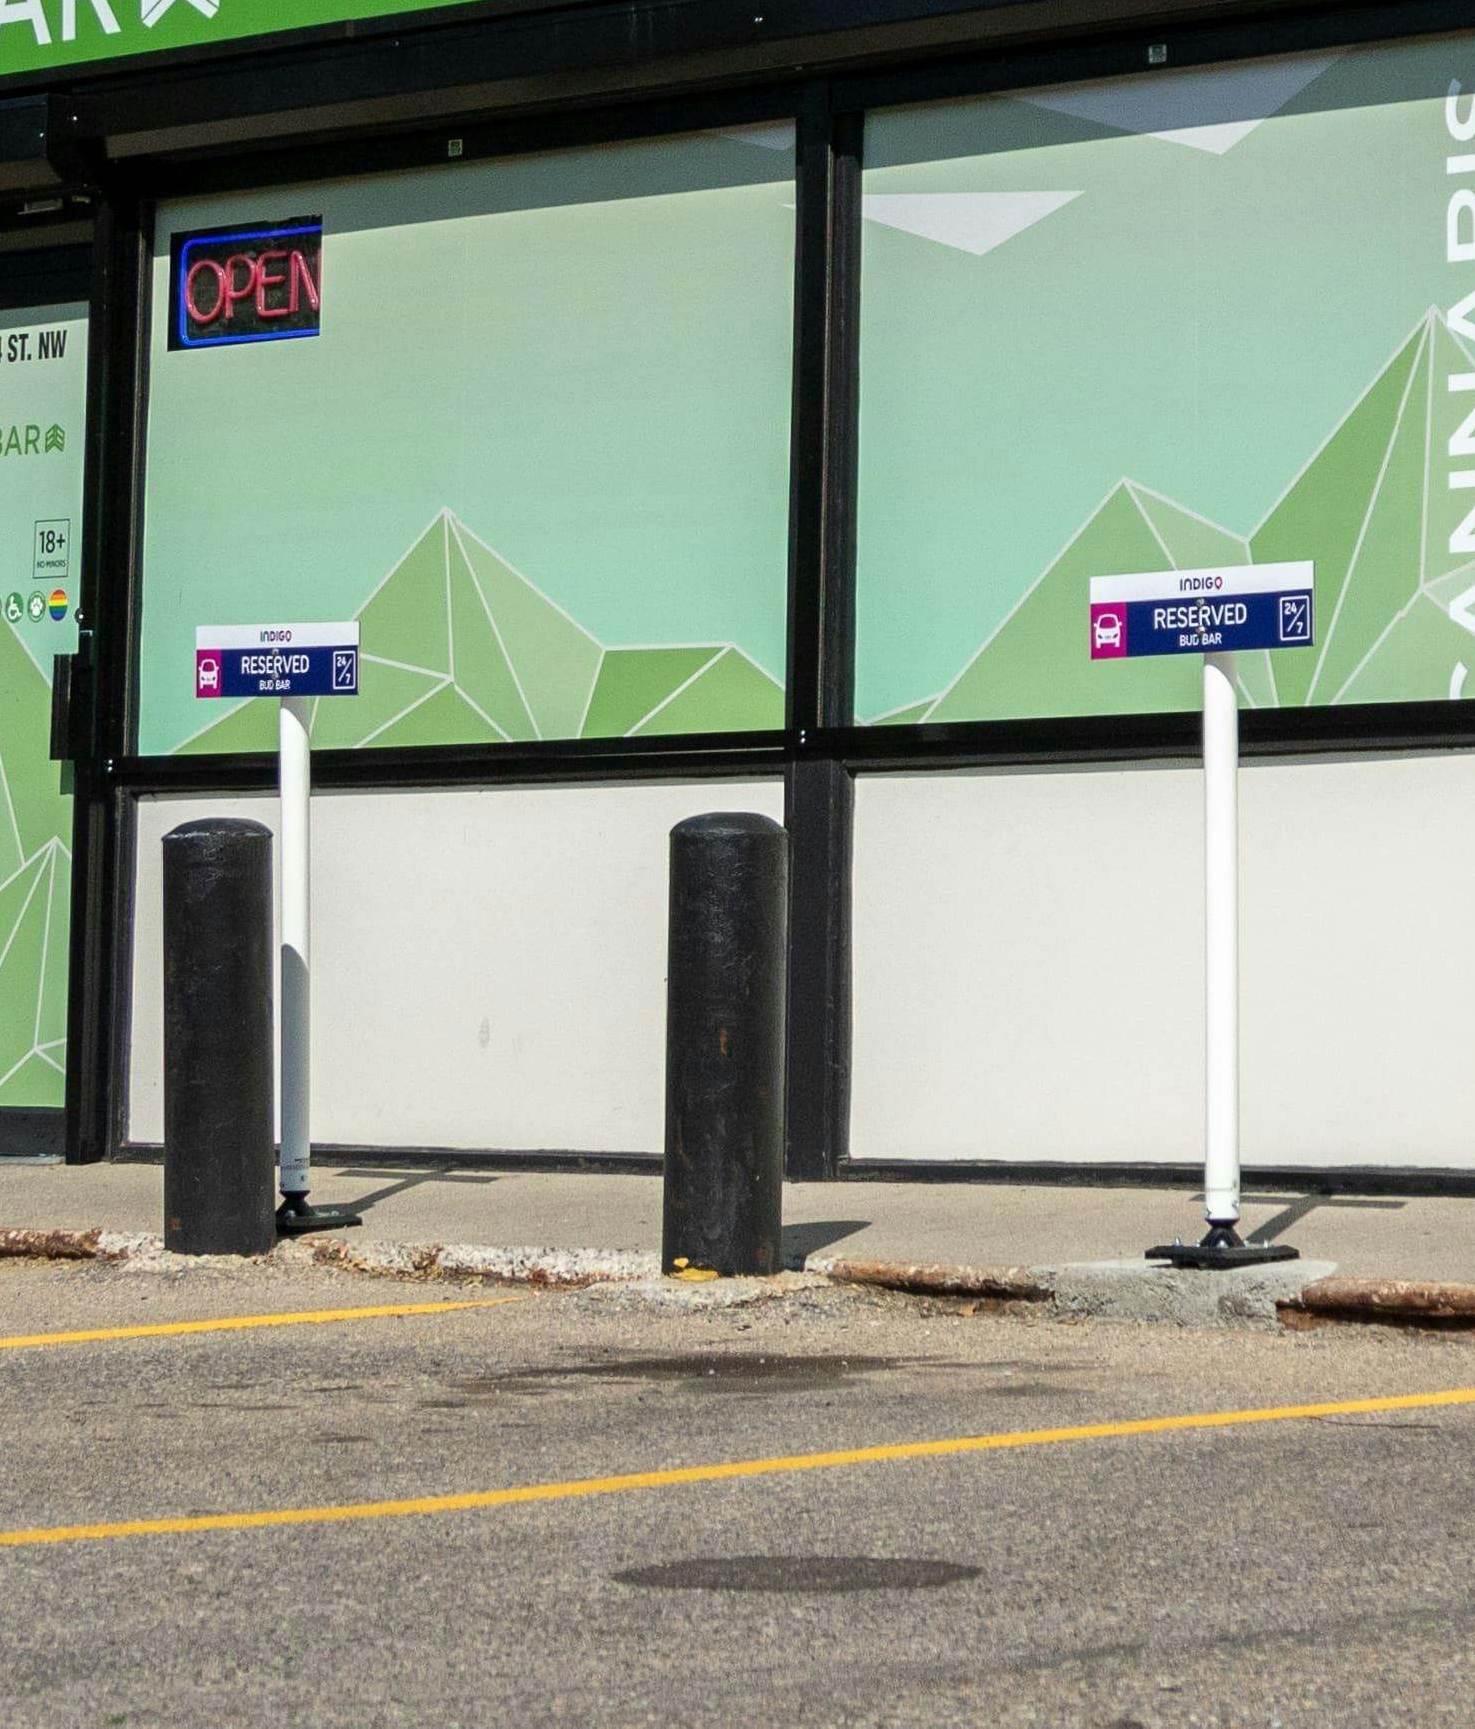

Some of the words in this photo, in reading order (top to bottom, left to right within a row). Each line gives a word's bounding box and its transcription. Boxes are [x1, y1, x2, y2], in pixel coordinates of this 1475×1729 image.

[185, 248, 322, 324] OPEN
[7, 333, 32, 363] ST.
[38, 330, 68, 359] NW
[39, 530, 66, 554] 18+
[1154, 603, 1247, 629] RESERVED
[1284, 603, 1305, 634] 24/7
[1179, 634, 1200, 647] BUD
[1201, 633, 1222, 646] BAR
[241, 655, 310, 675] RESERVED
[259, 680, 274, 690] BUD
[275, 679, 291, 690] BAR
